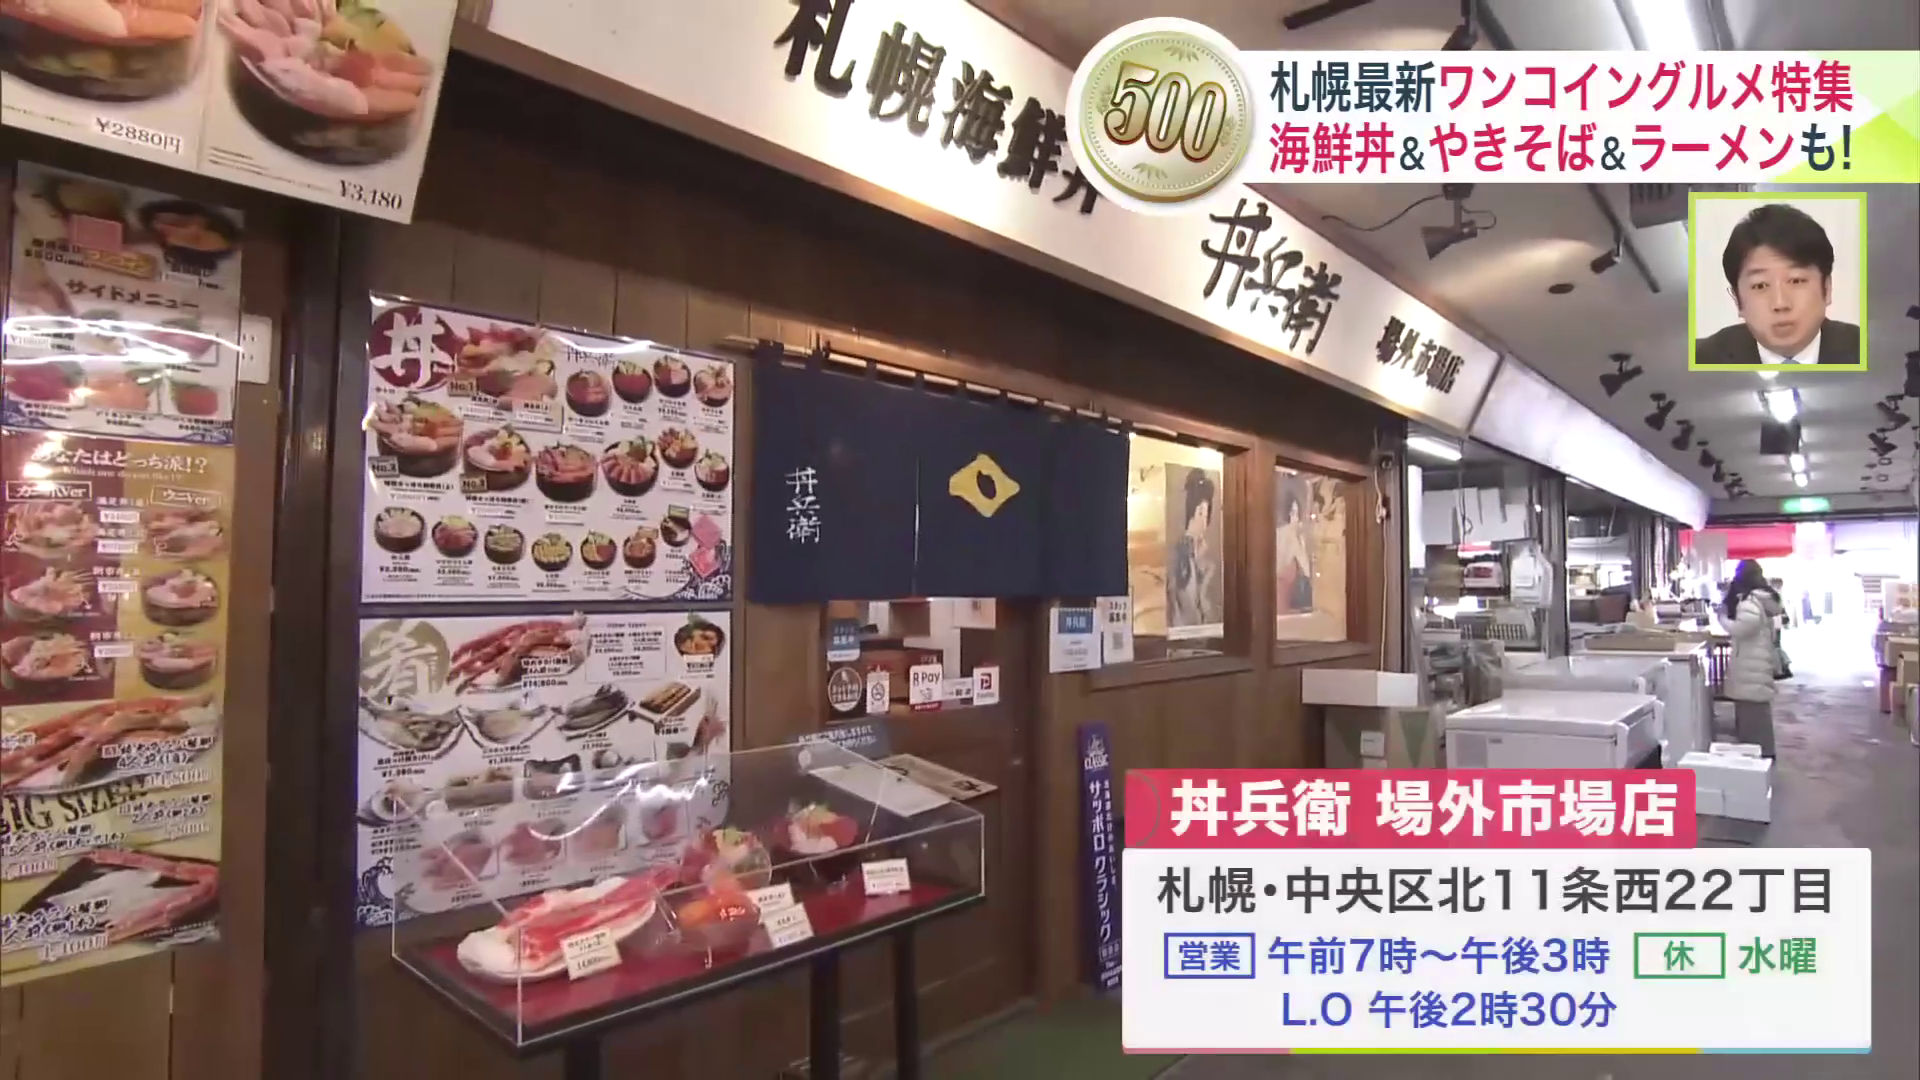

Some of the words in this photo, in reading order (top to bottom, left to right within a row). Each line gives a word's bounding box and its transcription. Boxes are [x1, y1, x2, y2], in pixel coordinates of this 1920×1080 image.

[65, 279, 200, 310] サイドメニュー
[785, 466, 821, 544] 丼兵衛
